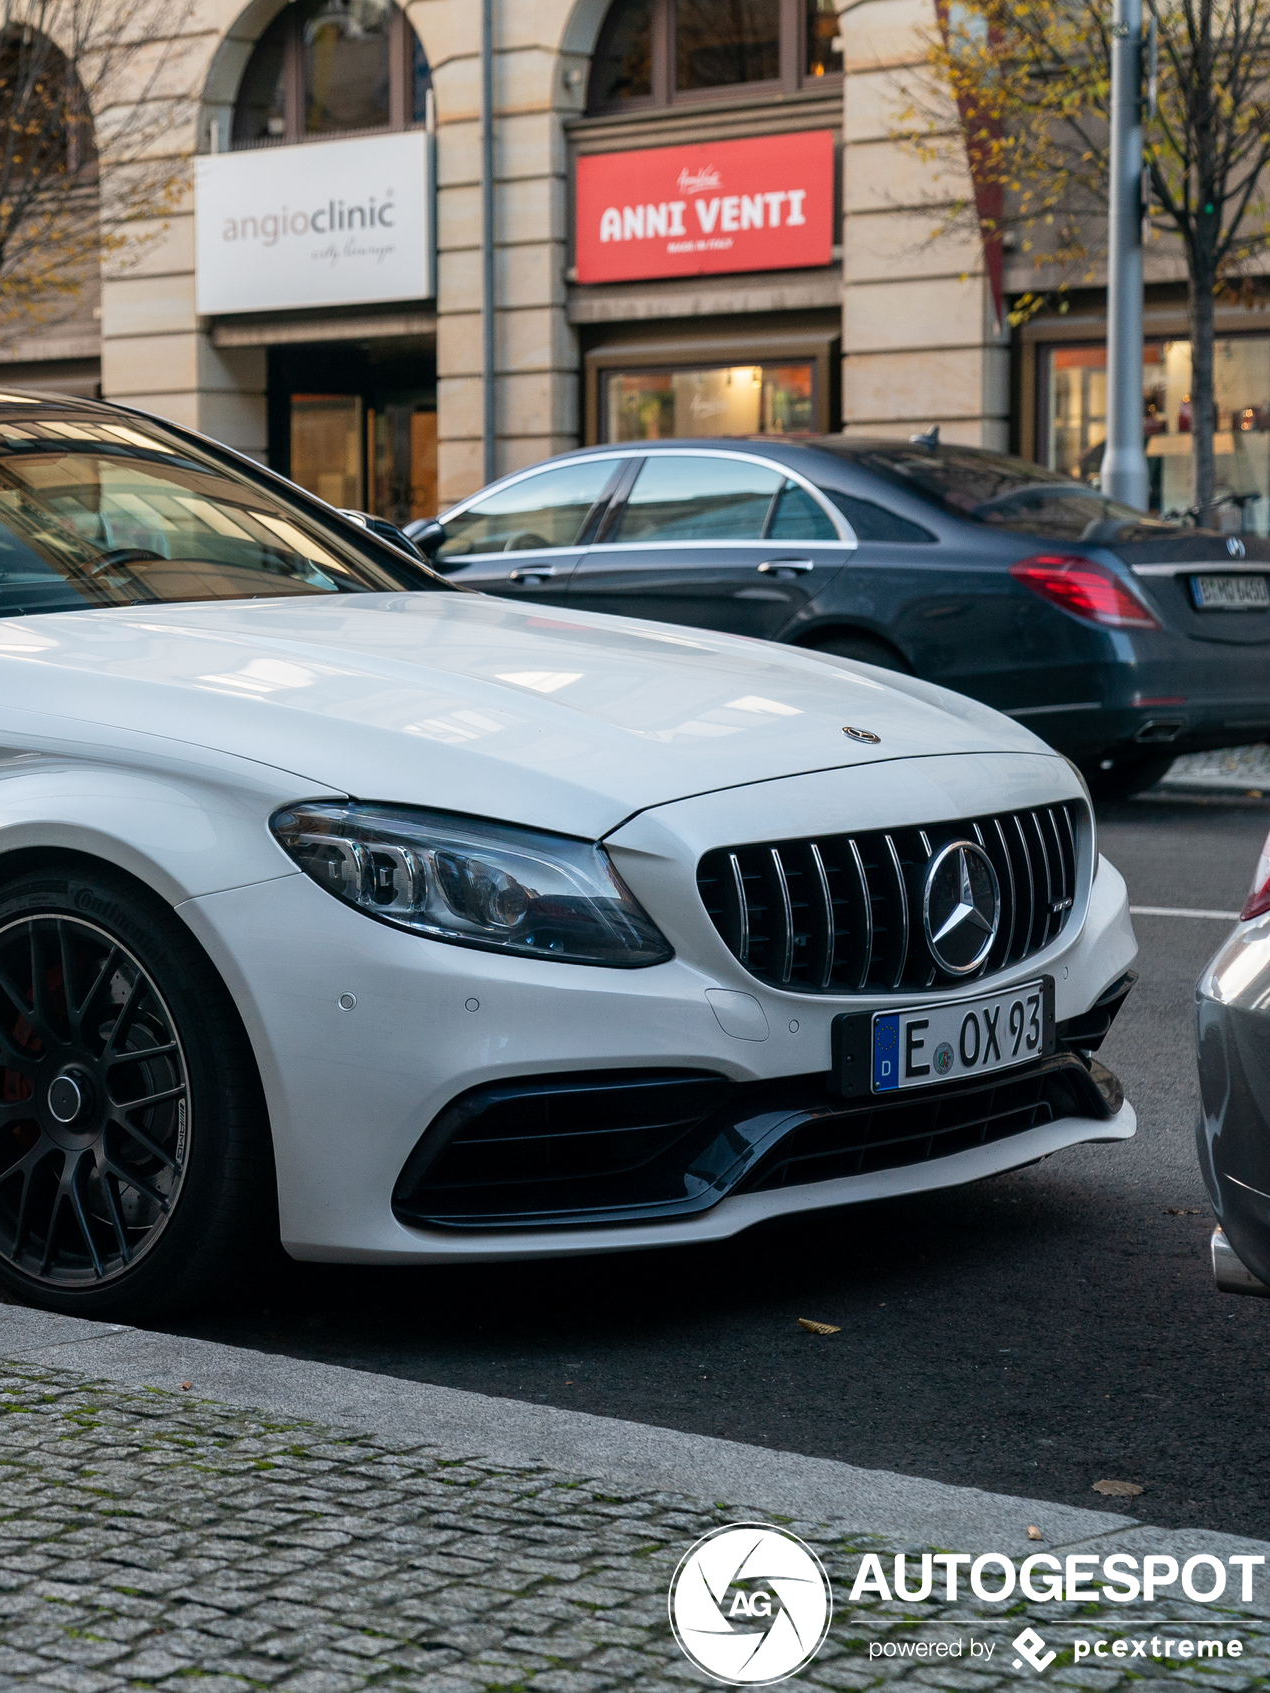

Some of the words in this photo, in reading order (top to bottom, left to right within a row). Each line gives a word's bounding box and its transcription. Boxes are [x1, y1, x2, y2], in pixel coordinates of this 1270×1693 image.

[222, 196, 395, 247] angioclinic
[600, 201, 686, 242] ANNI
[695, 189, 806, 234] VENTI
[905, 1018, 930, 1078] E
[959, 1005, 1001, 1068] OX
[1009, 993, 1040, 1056] 93
[881, 1060, 891, 1077] D
